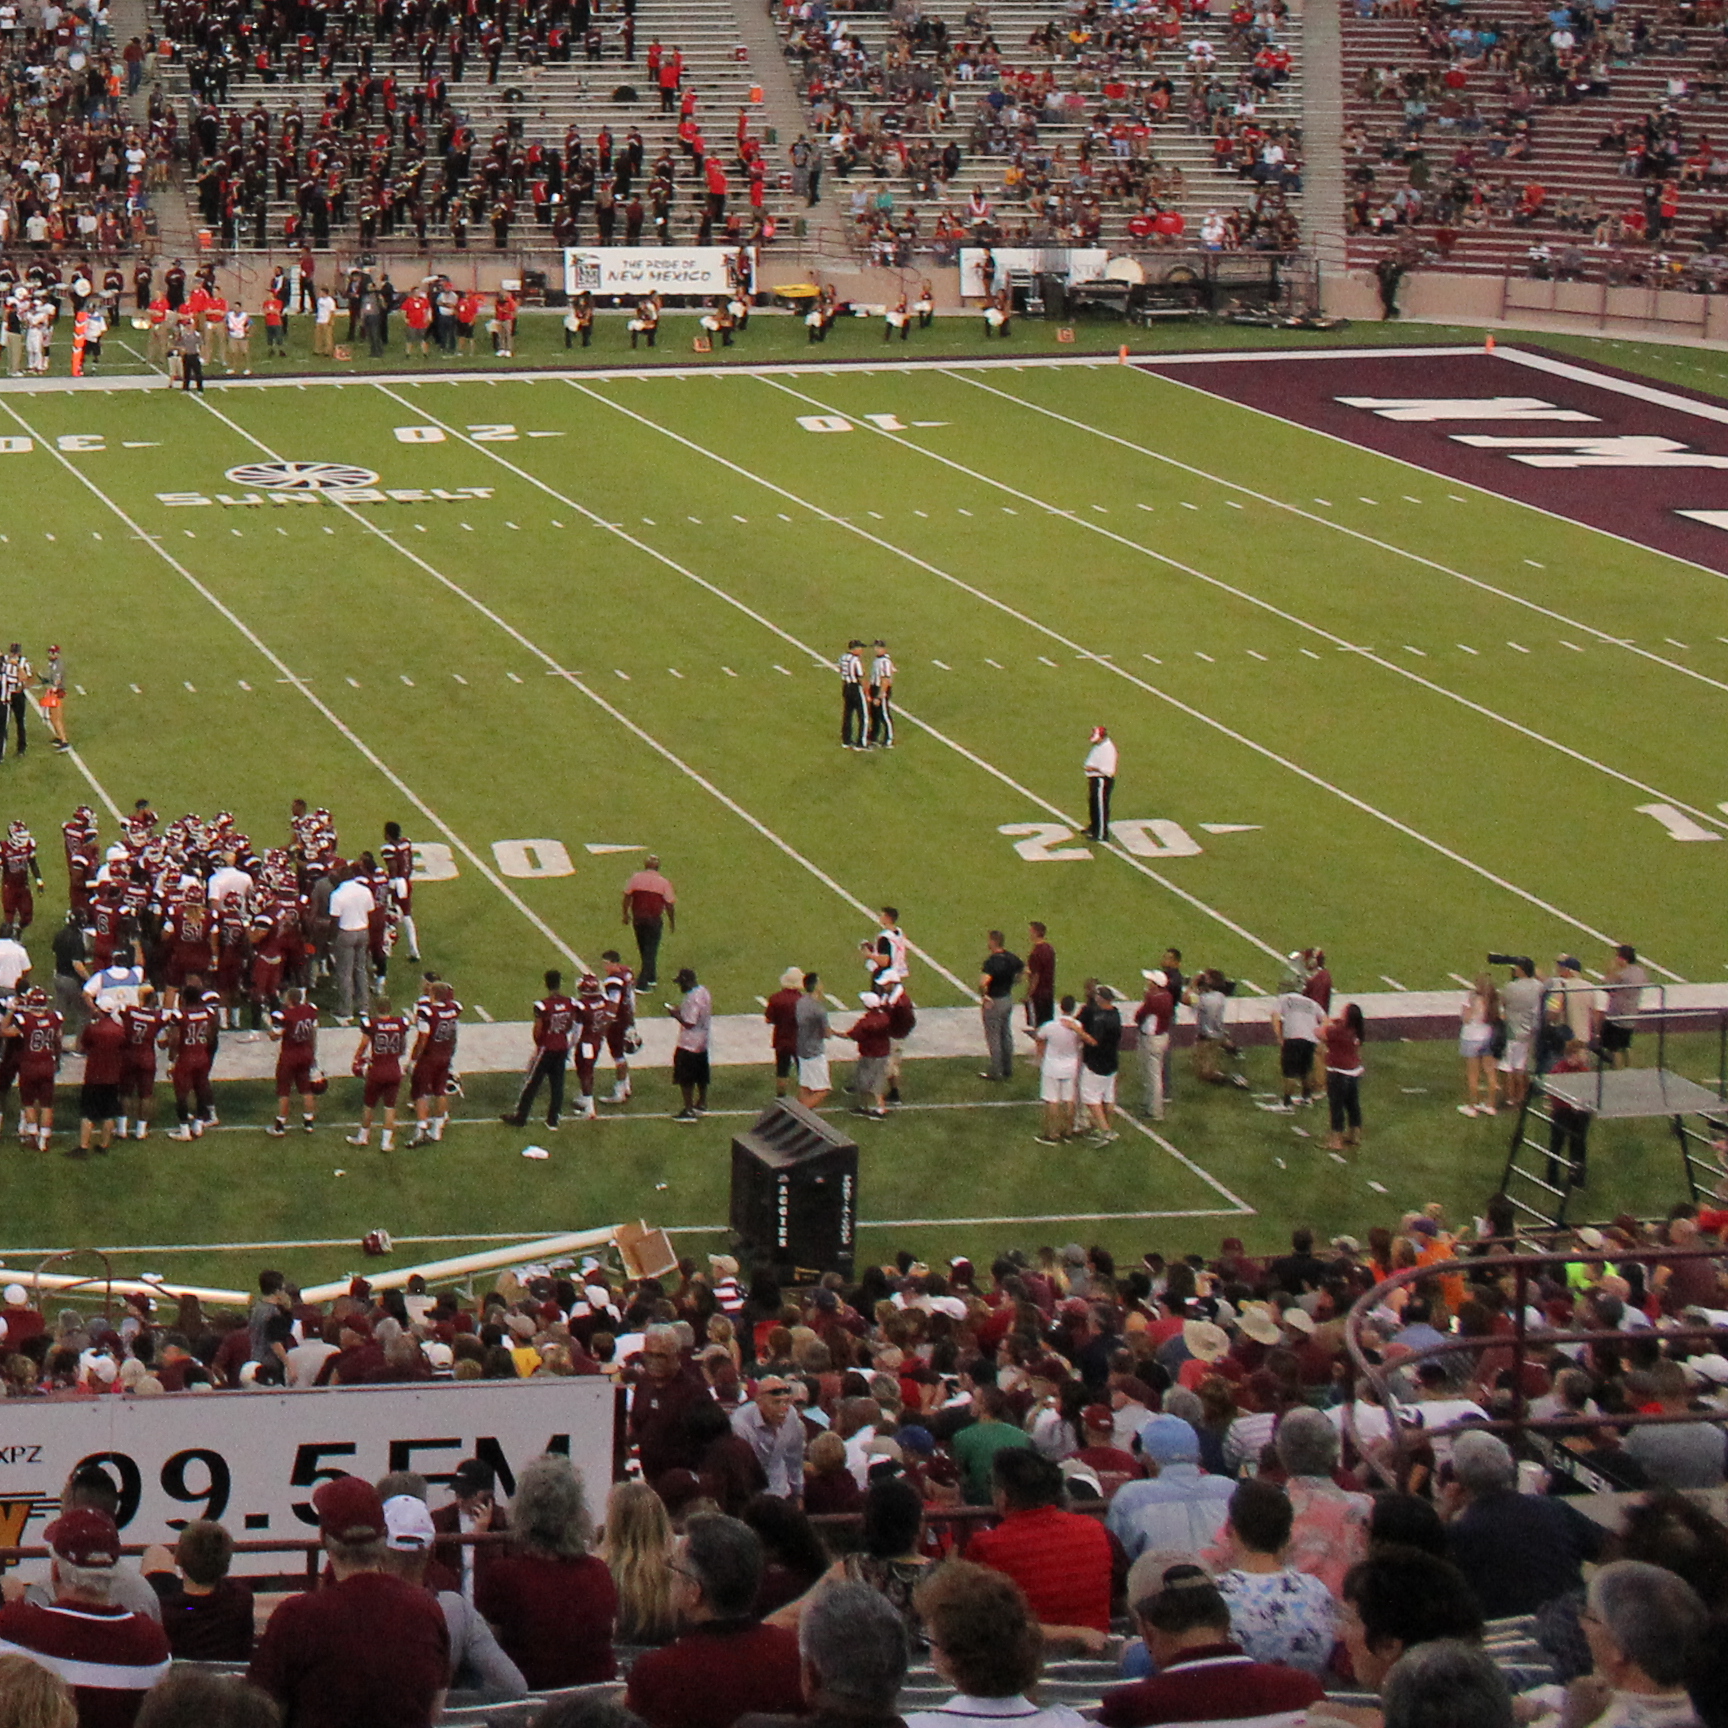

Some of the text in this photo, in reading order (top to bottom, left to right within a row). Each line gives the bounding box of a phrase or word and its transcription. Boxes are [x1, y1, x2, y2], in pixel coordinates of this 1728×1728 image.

[623, 259, 696, 269] THE PRIDE OF
[607, 270, 644, 282] NEW
[648, 270, 712, 282] MEXICO
[797, 413, 908, 433] 10
[393, 423, 520, 444] 20
[154, 491, 322, 507] SUN
[331, 487, 496, 503] BELT
[996, 817, 1205, 863] 20
